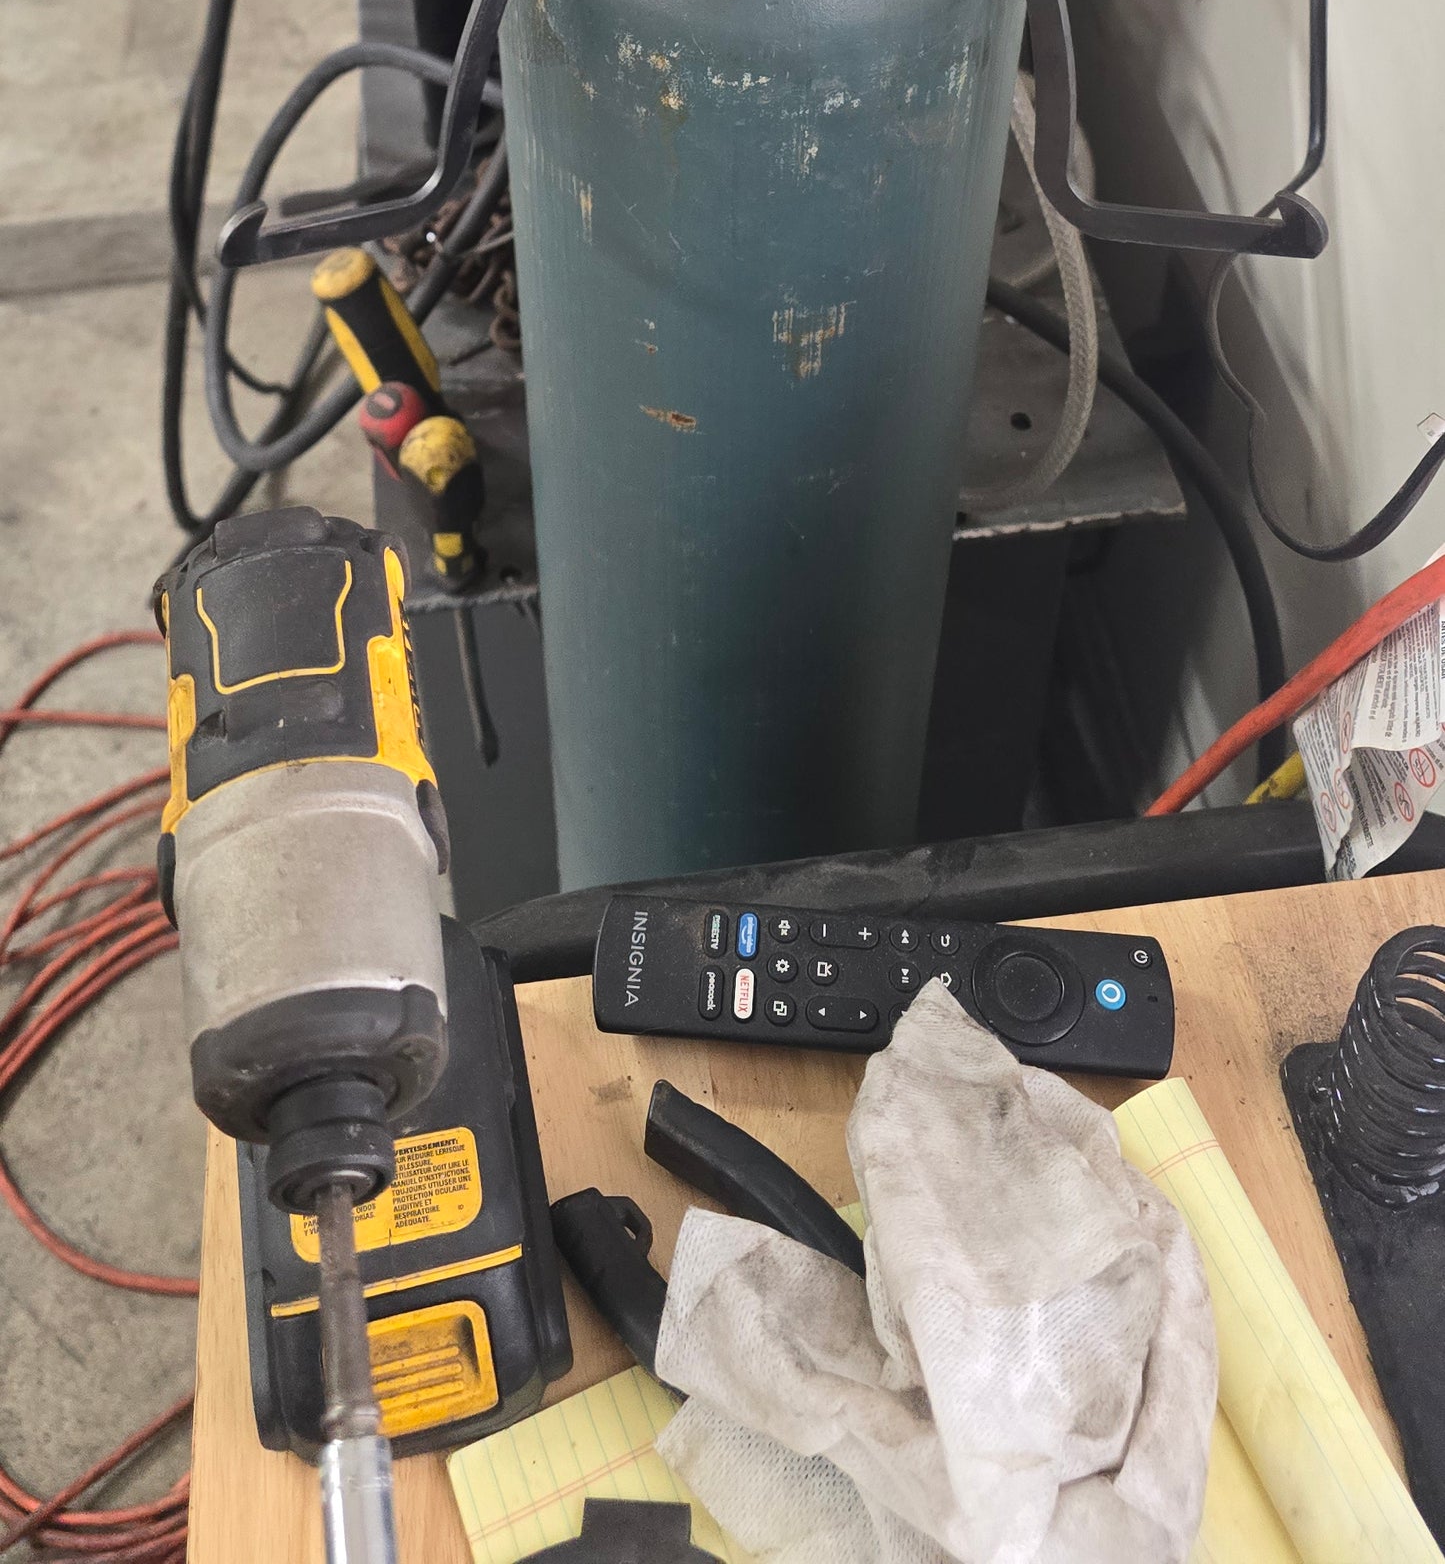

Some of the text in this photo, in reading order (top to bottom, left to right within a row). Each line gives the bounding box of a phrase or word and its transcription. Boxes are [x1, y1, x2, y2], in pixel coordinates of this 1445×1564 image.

[710, 914, 722, 950] DIRECTV
[625, 910, 649, 1007] INSIGNIA
[706, 971, 717, 1011] peacock
[737, 974, 750, 1013] NETFLIX
[433, 1164, 447, 1172] DOIT
[448, 1161, 461, 1169] LIRE
[391, 1178, 419, 1189] MANUEL
[392, 1174, 472, 1196] TOUJOURS UTILISER UNE
[392, 1191, 434, 1205] PROTECTION
[393, 1198, 432, 1213] AUDITIVE ET
[394, 1204, 440, 1221] RESPIRATOIRE
